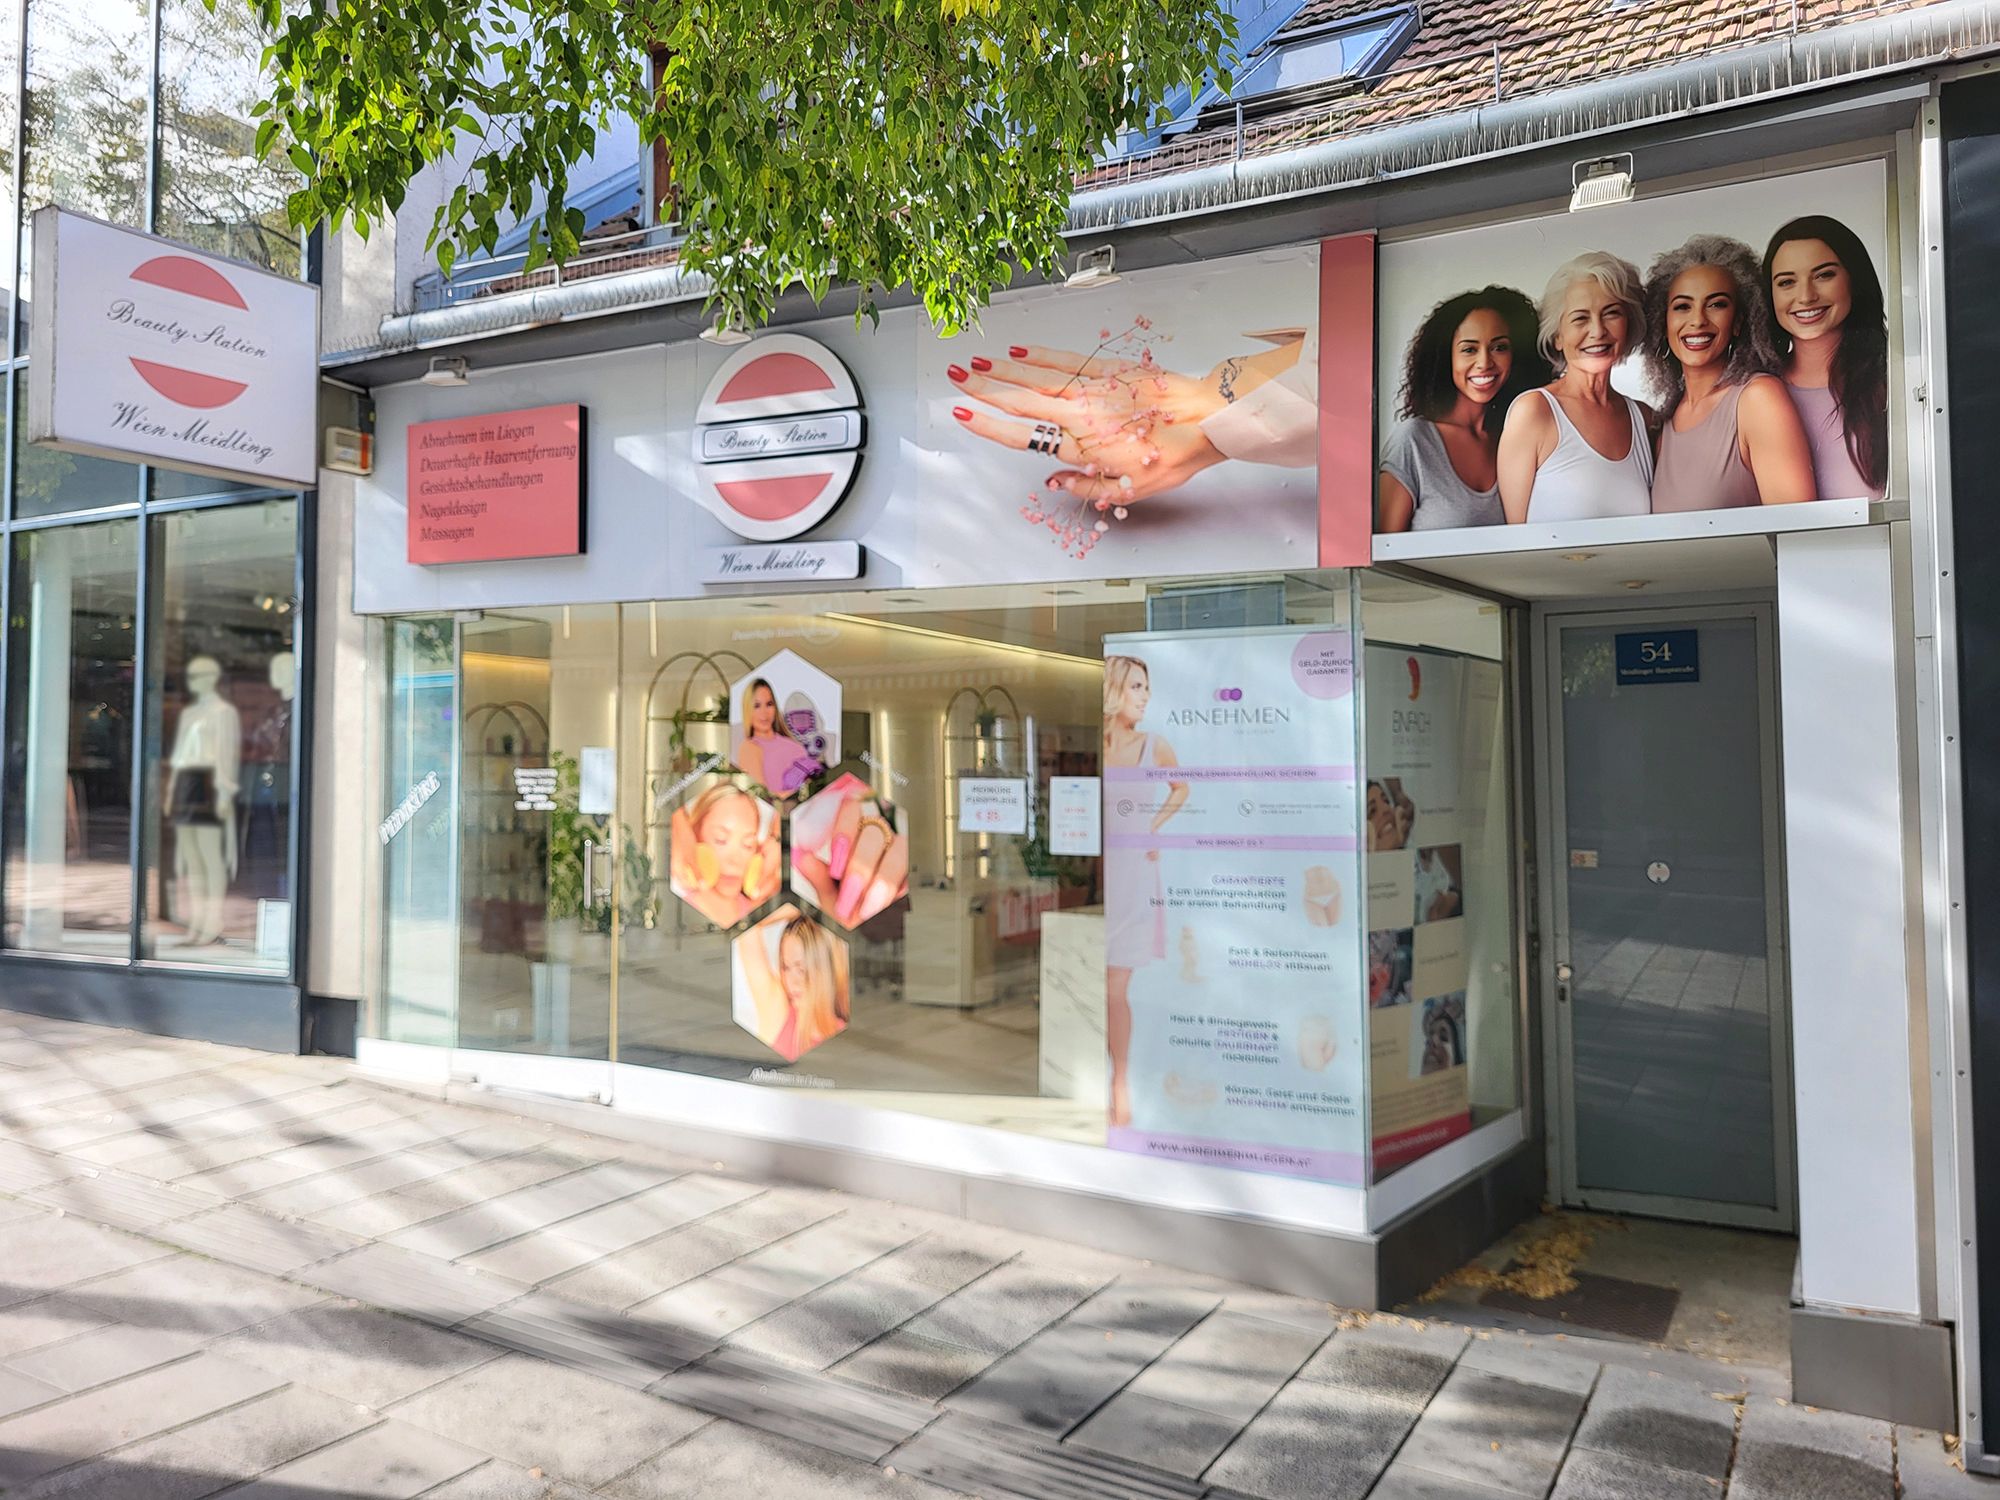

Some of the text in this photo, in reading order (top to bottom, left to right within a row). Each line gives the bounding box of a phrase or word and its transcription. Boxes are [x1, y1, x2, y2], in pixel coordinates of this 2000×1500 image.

[107, 300, 269, 358] Beauty Station
[113, 401, 273, 464] Wien Meidling
[419, 424, 535, 449] Abnehmen im Liegen
[719, 425, 828, 453] Beauty Station
[420, 445, 577, 472] Dauerhafte Haarentfernung
[420, 472, 544, 495] Gesichtsbehandlungen
[419, 500, 487, 520] Nageldesign
[420, 526, 474, 542] Massagen
[719, 550, 826, 575] Wien Meidling
[1641, 641, 1672, 663] 54
[1166, 706, 1291, 726] ABNEHMEN
